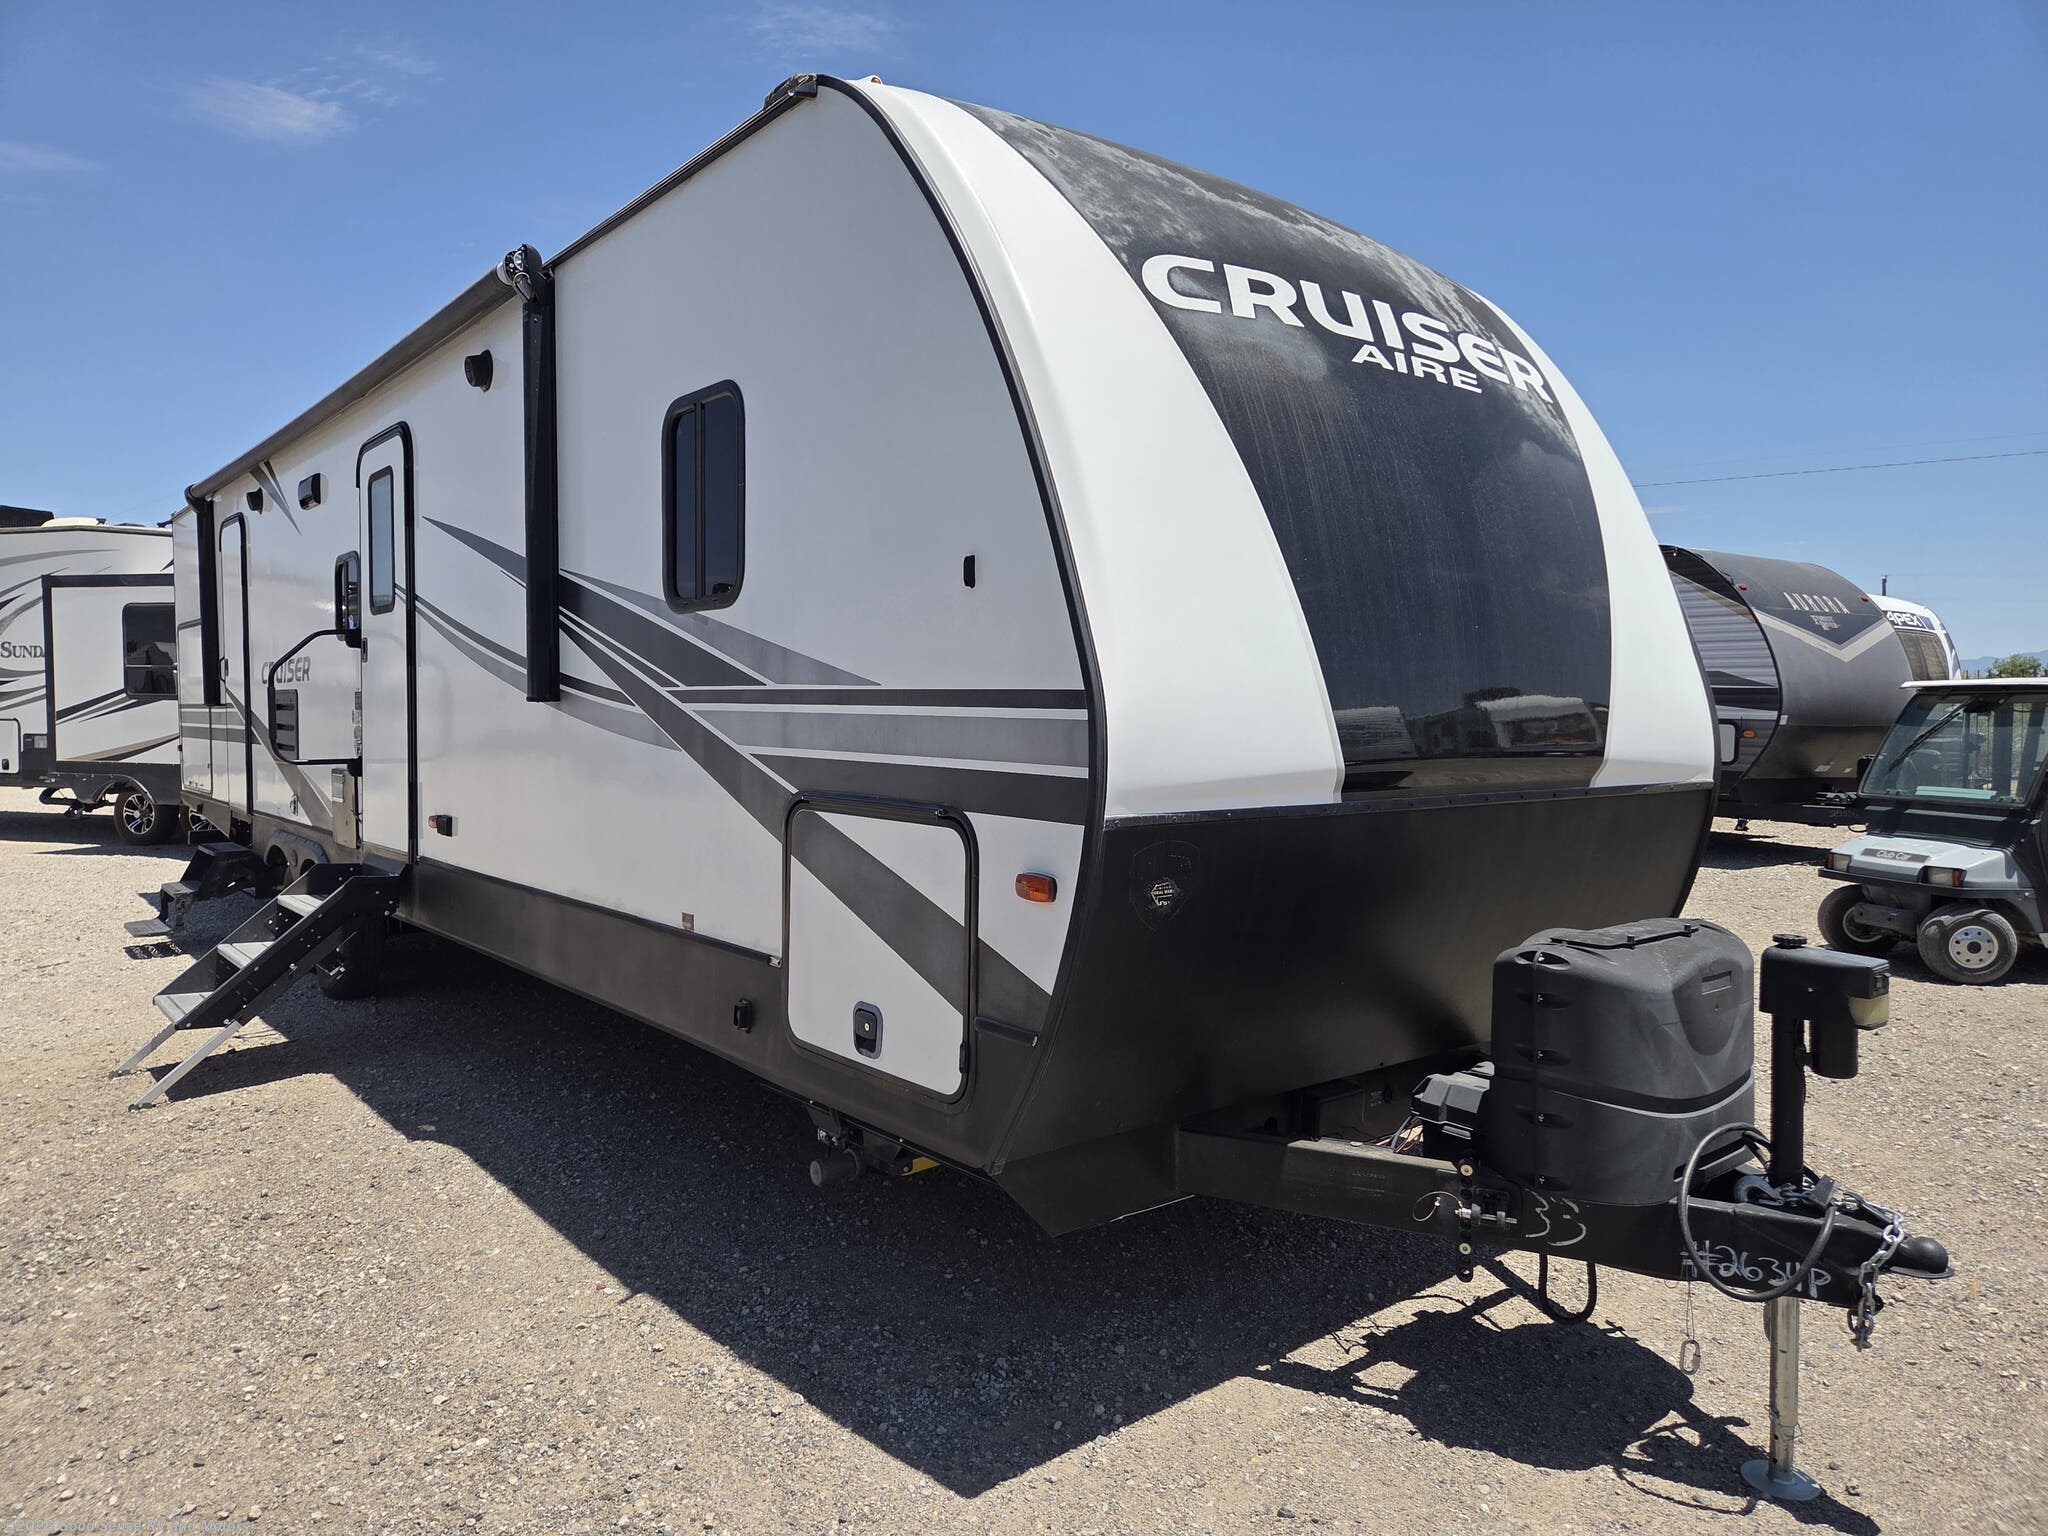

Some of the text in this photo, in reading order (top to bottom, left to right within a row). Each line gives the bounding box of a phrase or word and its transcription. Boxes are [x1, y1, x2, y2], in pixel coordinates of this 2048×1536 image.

[1141, 253, 1554, 404] CRUISER
[1351, 344, 1482, 394] AIRE
[1783, 591, 1851, 614] AURORA
[1886, 610, 1922, 627] APEX
[0, 641, 45, 659] SUND
[1877, 850, 1895, 859] Club
